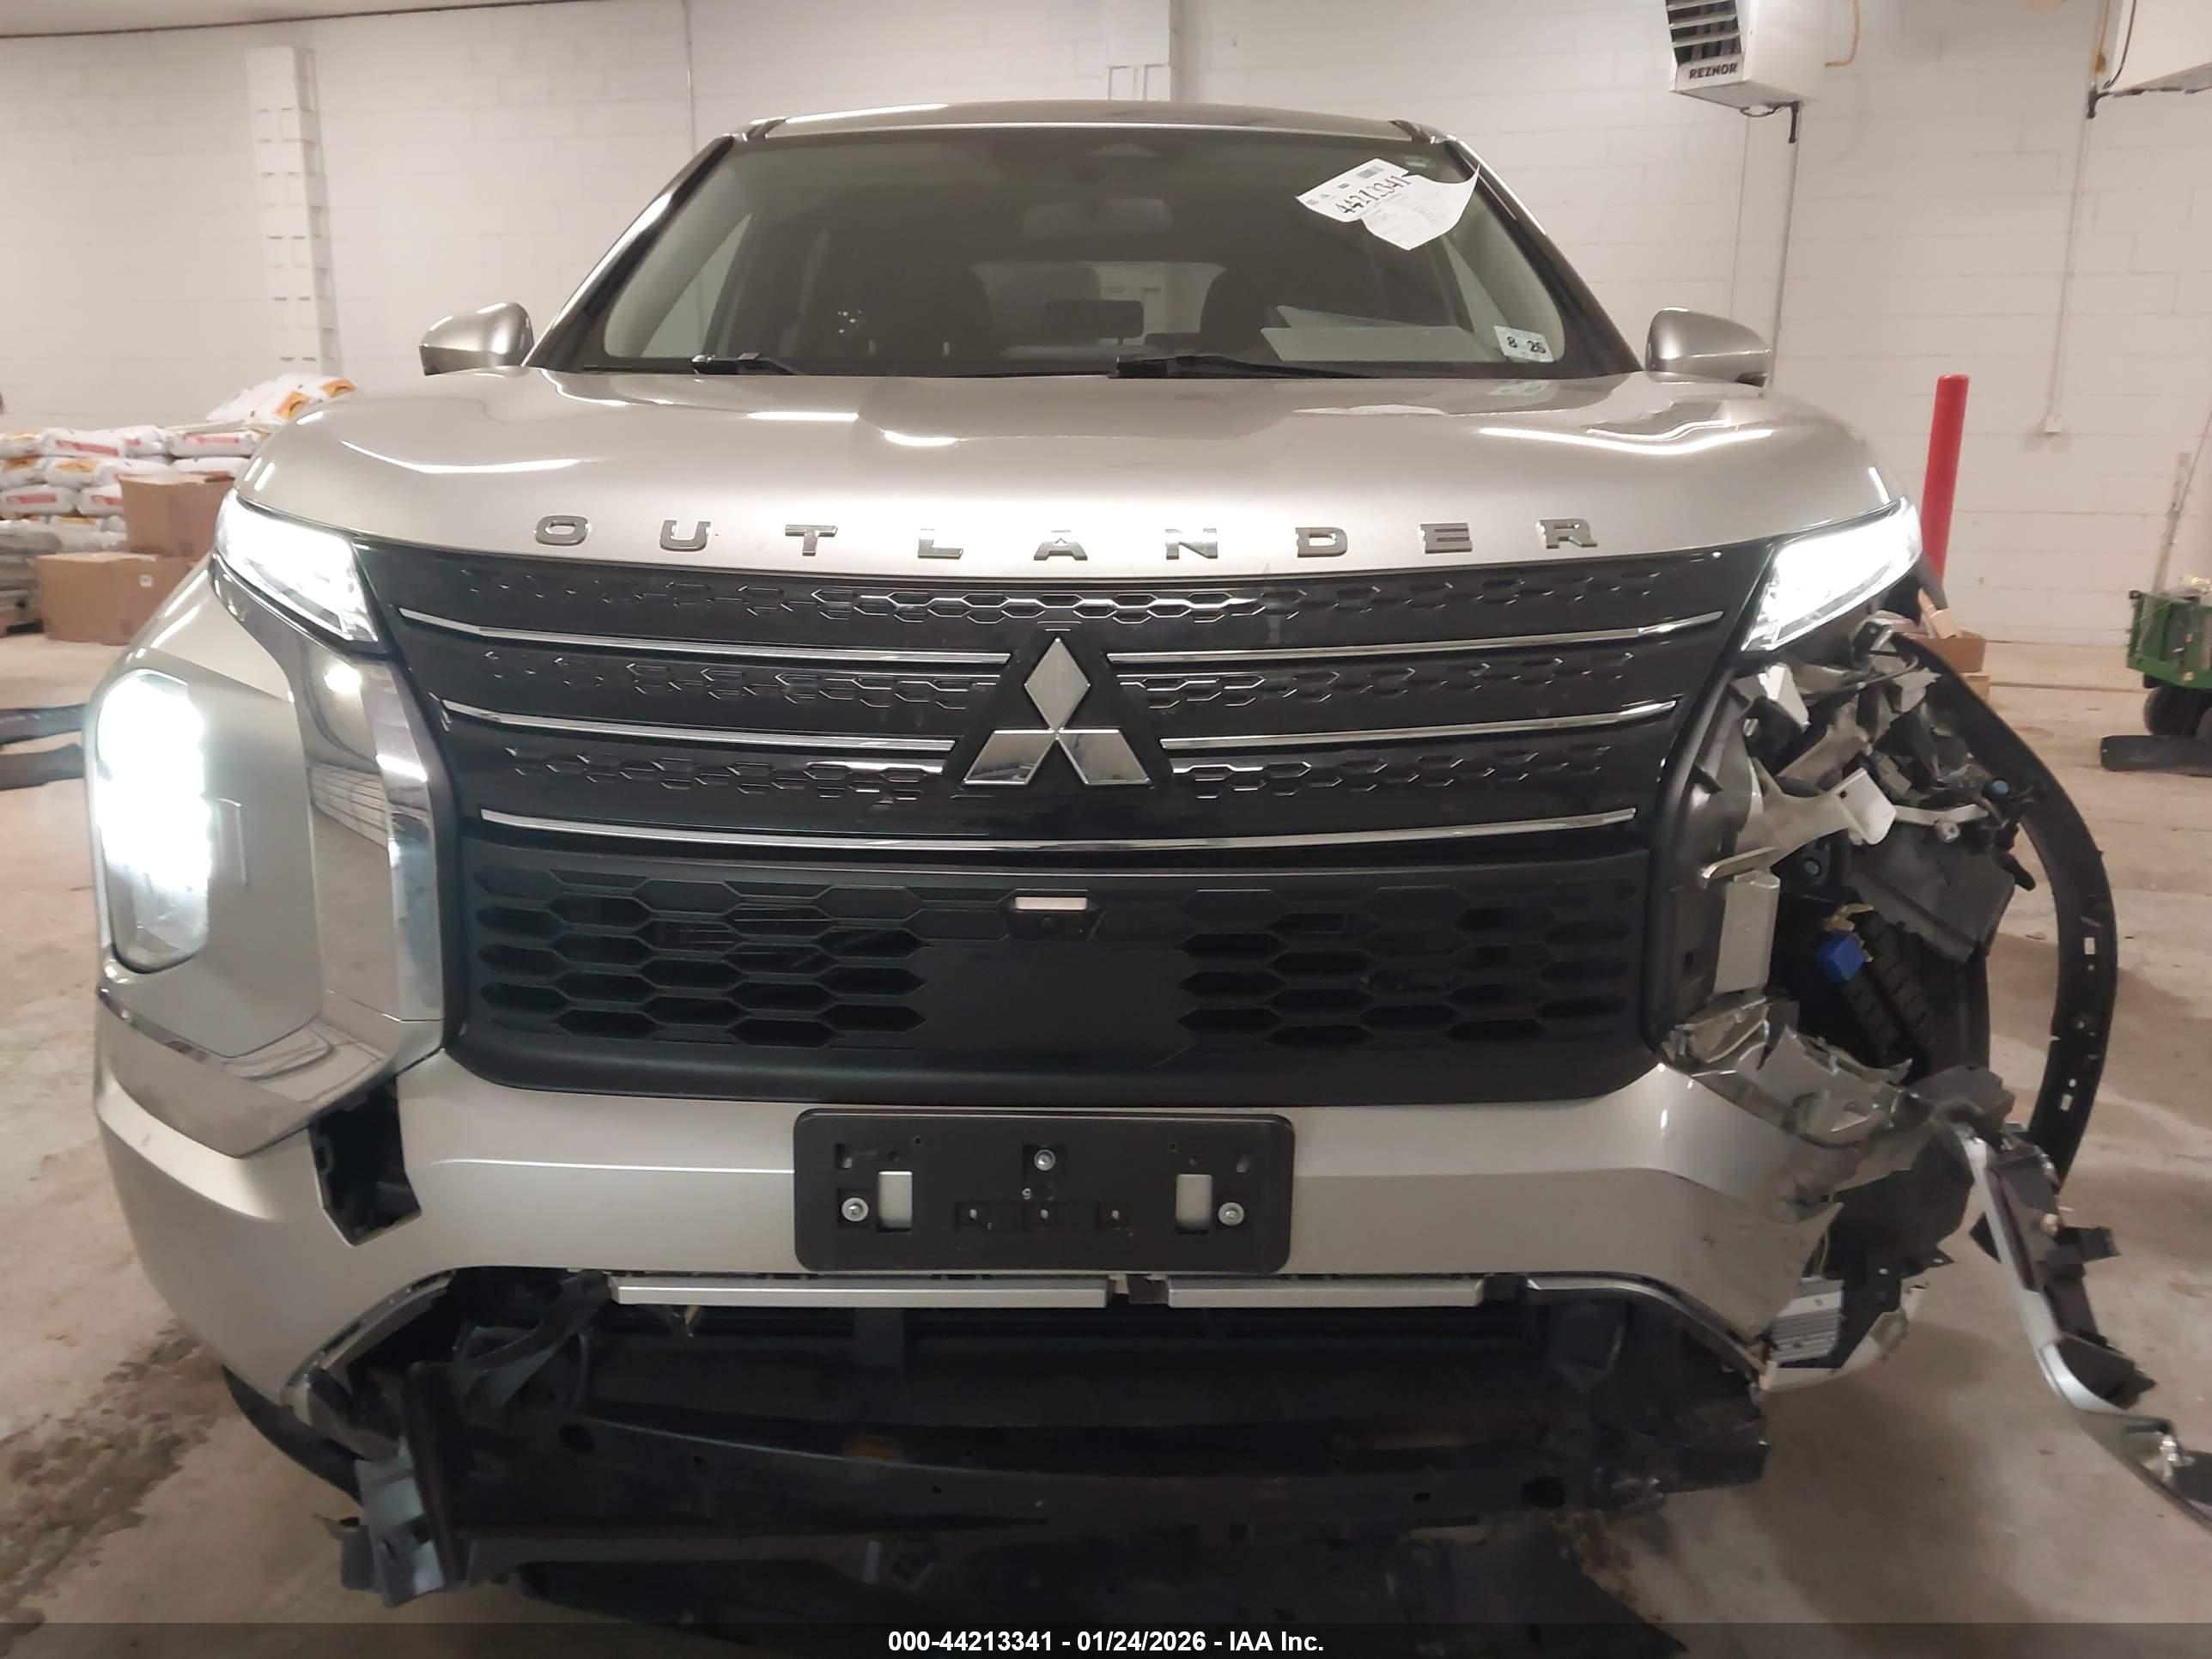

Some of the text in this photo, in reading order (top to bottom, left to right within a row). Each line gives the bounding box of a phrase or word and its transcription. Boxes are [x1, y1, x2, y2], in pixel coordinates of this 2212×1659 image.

[1689, 63, 1738, 79] REZNOR
[1507, 336, 1517, 349] 8
[534, 514, 1598, 562] OUTLANDER
